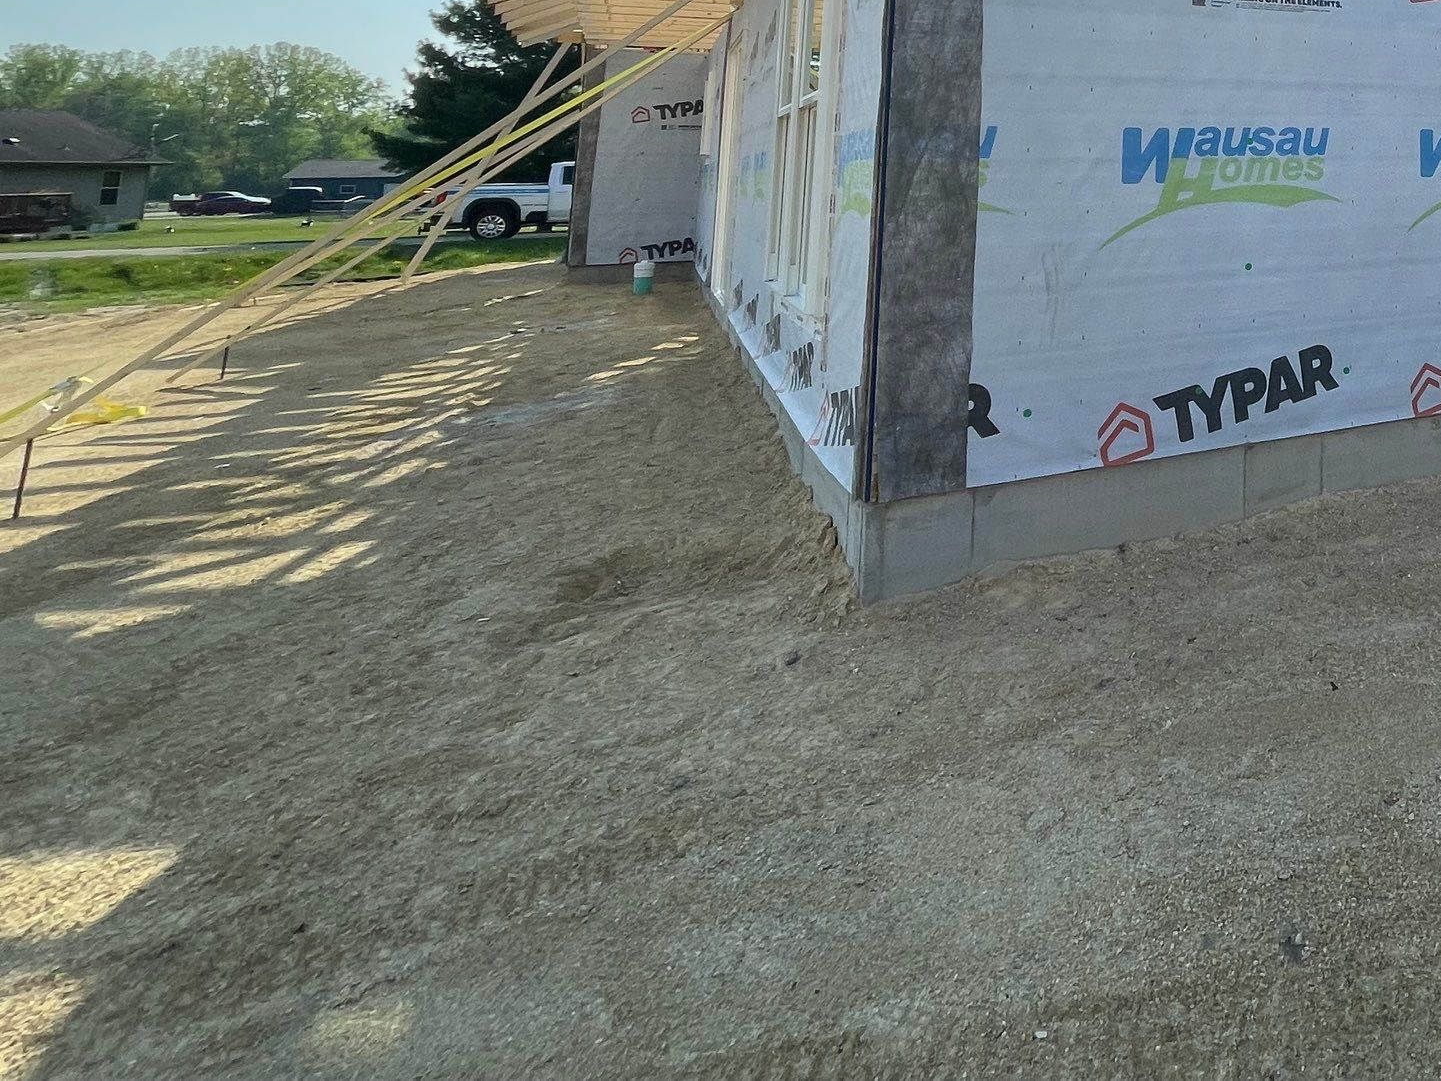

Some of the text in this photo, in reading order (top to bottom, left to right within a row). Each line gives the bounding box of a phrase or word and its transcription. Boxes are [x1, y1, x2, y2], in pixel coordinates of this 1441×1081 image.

[652, 99, 704, 120] TYPA
[1121, 126, 1330, 184] Wausau
[1160, 155, 1325, 205] Homes
[640, 237, 697, 260] TYPA
[1152, 344, 1340, 443] TYPAR
